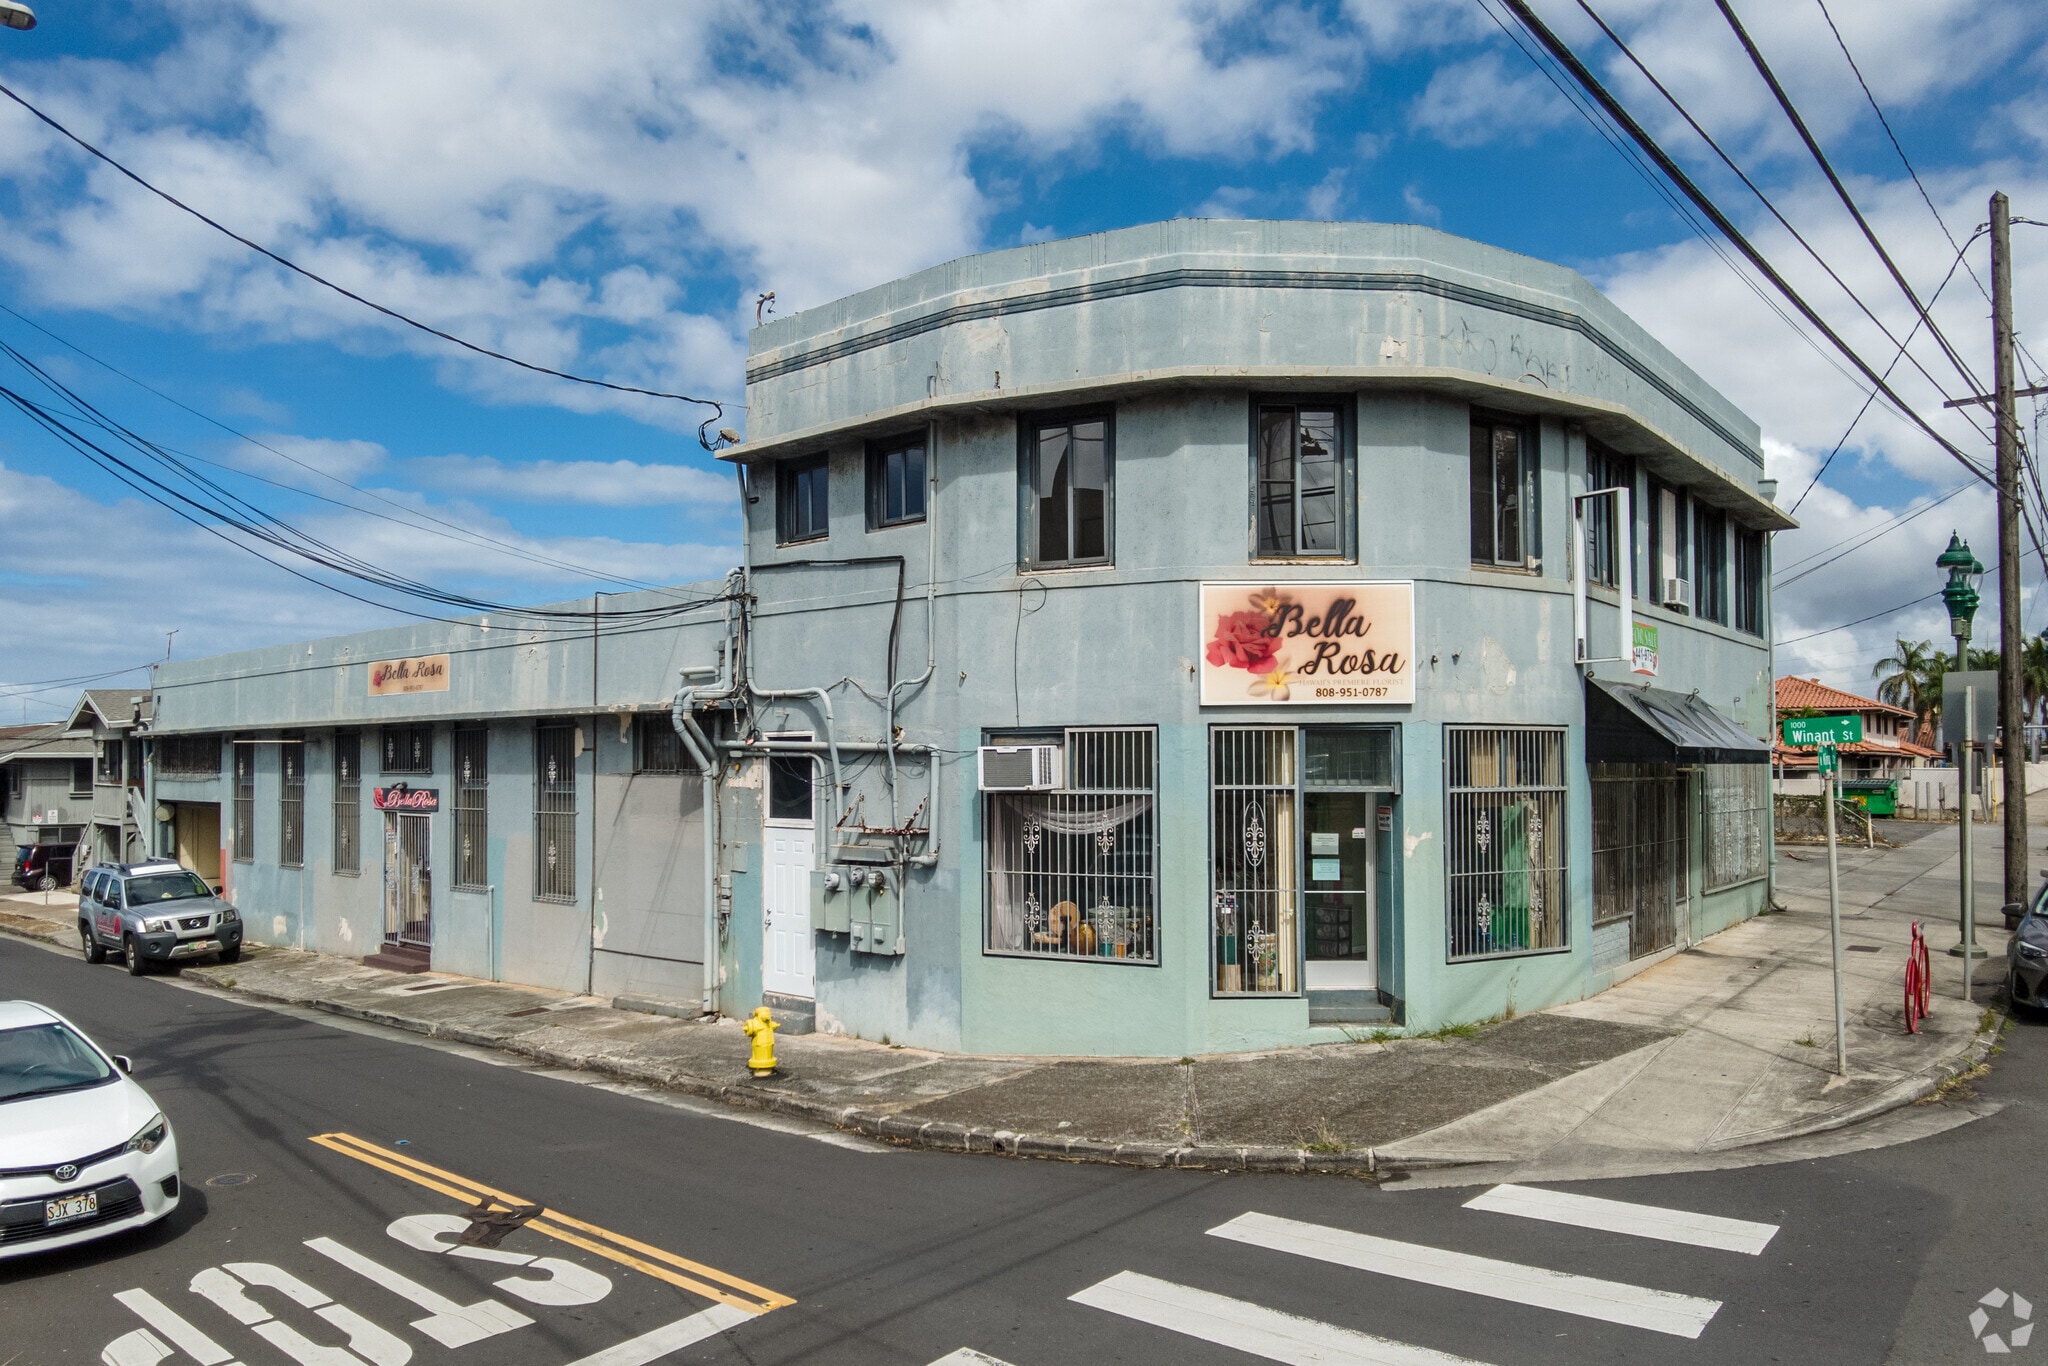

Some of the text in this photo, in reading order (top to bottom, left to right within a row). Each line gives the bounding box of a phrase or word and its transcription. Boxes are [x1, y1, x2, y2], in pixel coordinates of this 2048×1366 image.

[1261, 598, 1372, 638] Bella
[1645, 629, 1657, 648] SALE
[1297, 641, 1406, 675] Rosa
[381, 661, 444, 680] Bella Rosa
[1315, 687, 1388, 697] 808-951-0787
[1790, 721, 1806, 729] 1000
[1792, 729, 1853, 743] Winant St
[412, 790, 438, 808] Rosa
[47, 1203, 68, 1219] SJX
[75, 1197, 96, 1213] 378
